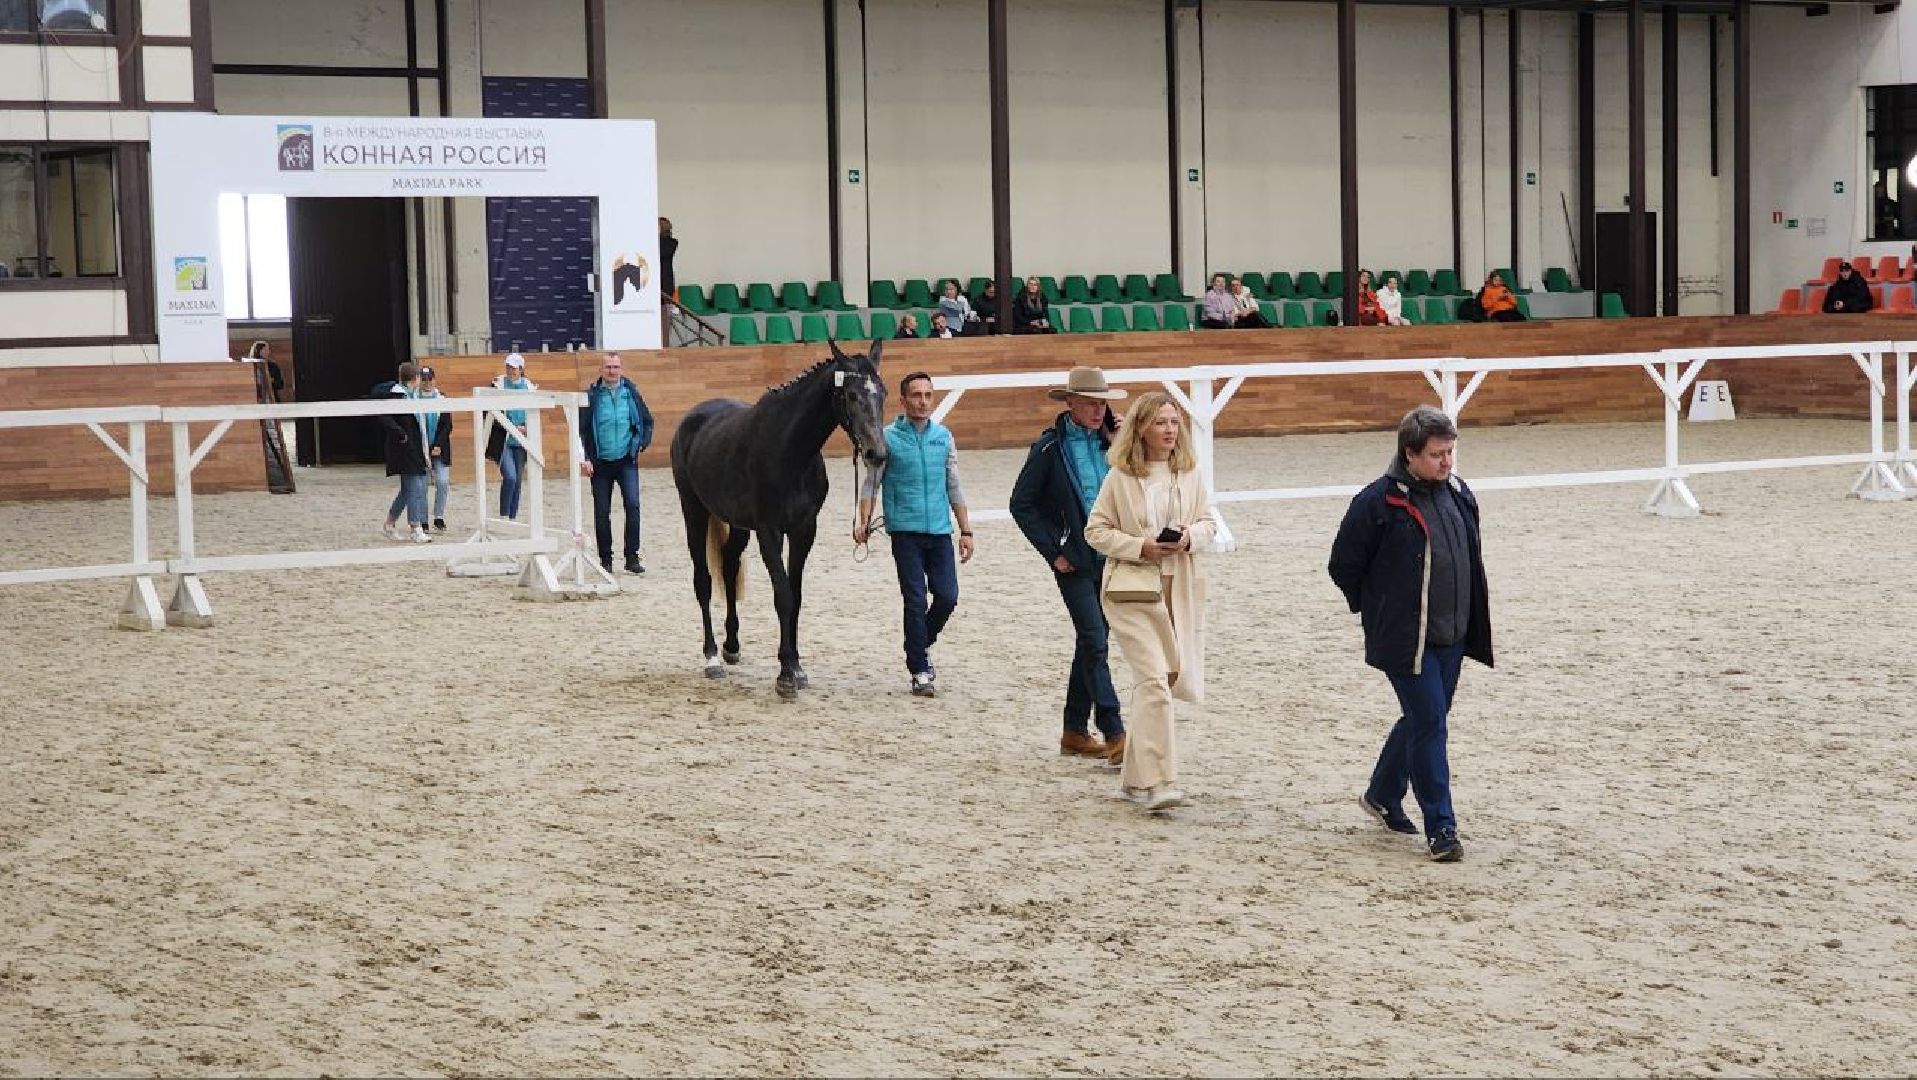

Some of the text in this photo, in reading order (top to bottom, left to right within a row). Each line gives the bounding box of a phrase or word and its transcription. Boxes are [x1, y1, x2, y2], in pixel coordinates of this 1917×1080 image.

[346, 127, 471, 140] МЕЖДУНАРОДНАЯ
[475, 127, 546, 140] ВЫСТАВКА
[323, 144, 546, 165] КОННАЯ РОССИЯ
[392, 178, 483, 189] MAXIMA PARK
[168, 300, 217, 311] MAXIMA
[1700, 385, 1726, 402] E E
